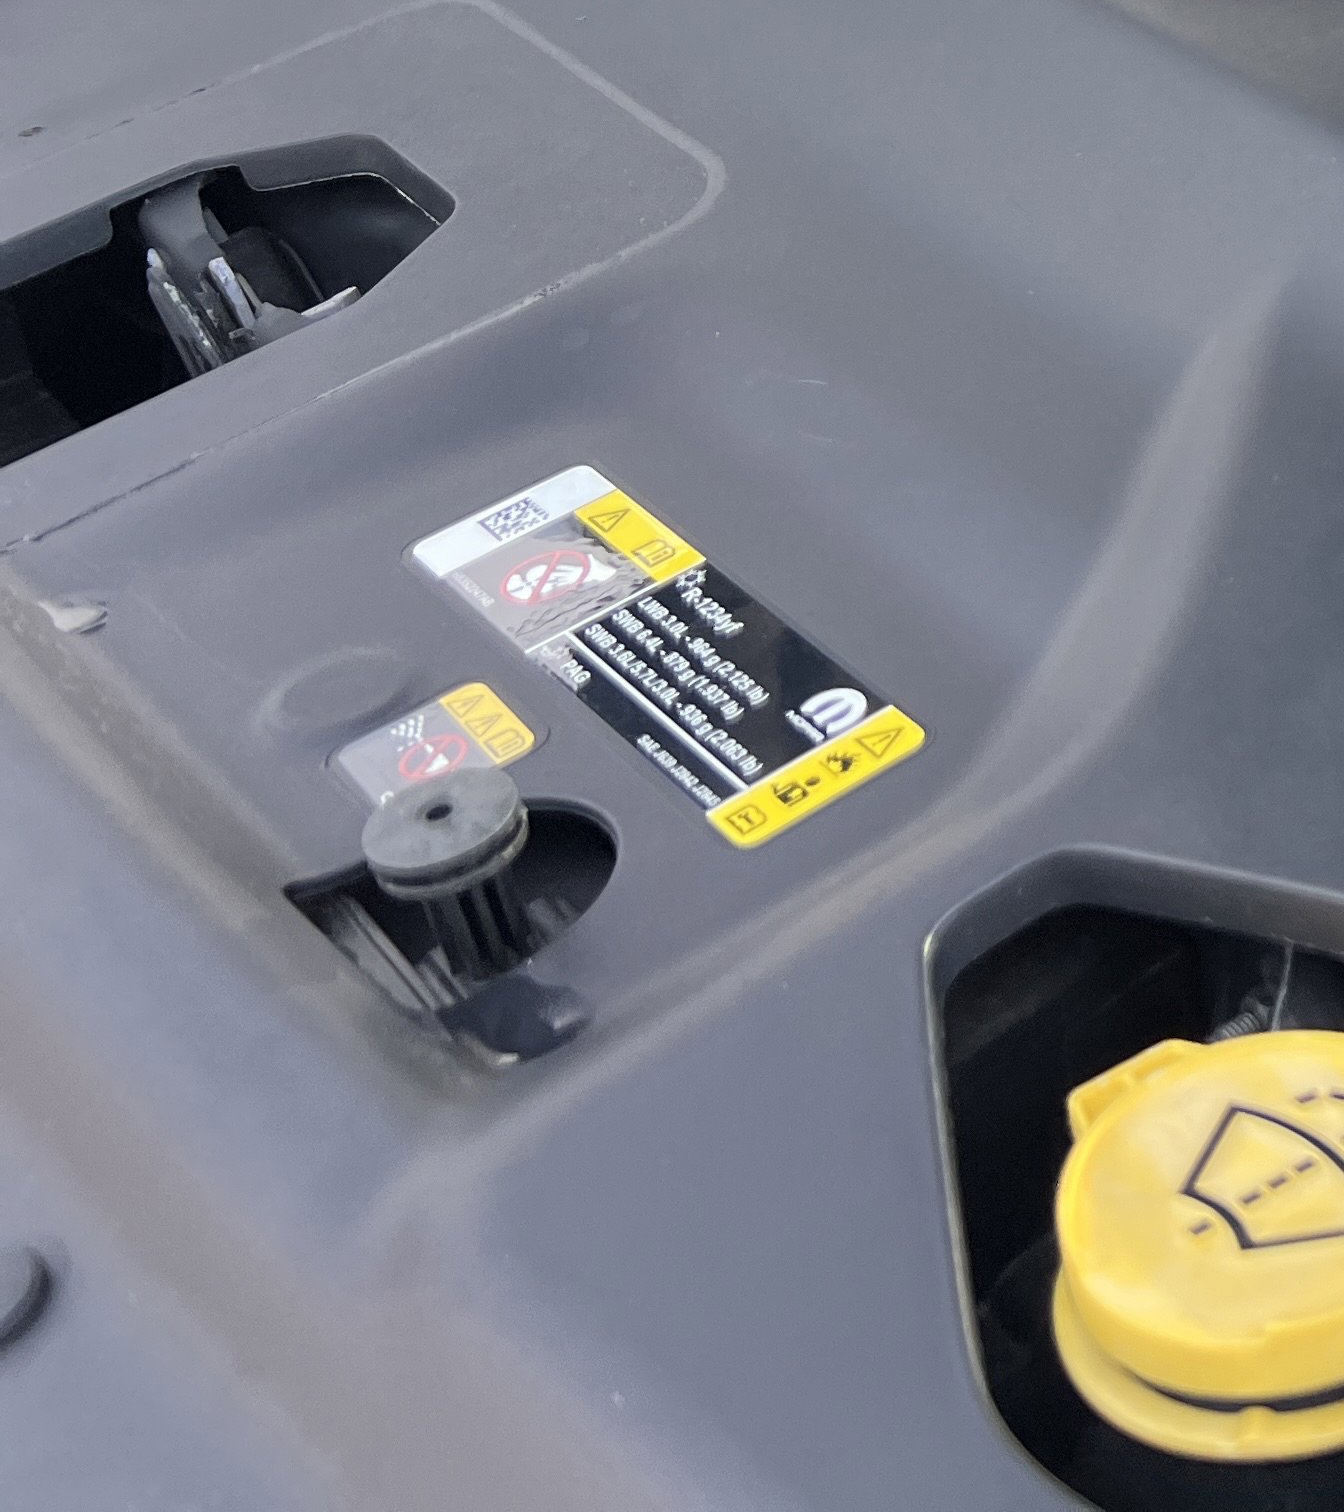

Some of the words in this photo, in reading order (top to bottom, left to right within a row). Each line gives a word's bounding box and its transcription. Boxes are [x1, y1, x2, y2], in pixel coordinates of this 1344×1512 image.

[611, 608, 649, 635] SWB
[636, 628, 664, 654] 6.4L
[720, 699, 745, 721] lb)
[637, 596, 670, 622] LWB
[662, 614, 689, 640] 3.0L
[746, 685, 770, 706] lb)
[681, 586, 745, 634] R-1234yf
[559, 658, 591, 684] PAG
[584, 623, 618, 650] SWB
[738, 754, 764, 777] lb)
